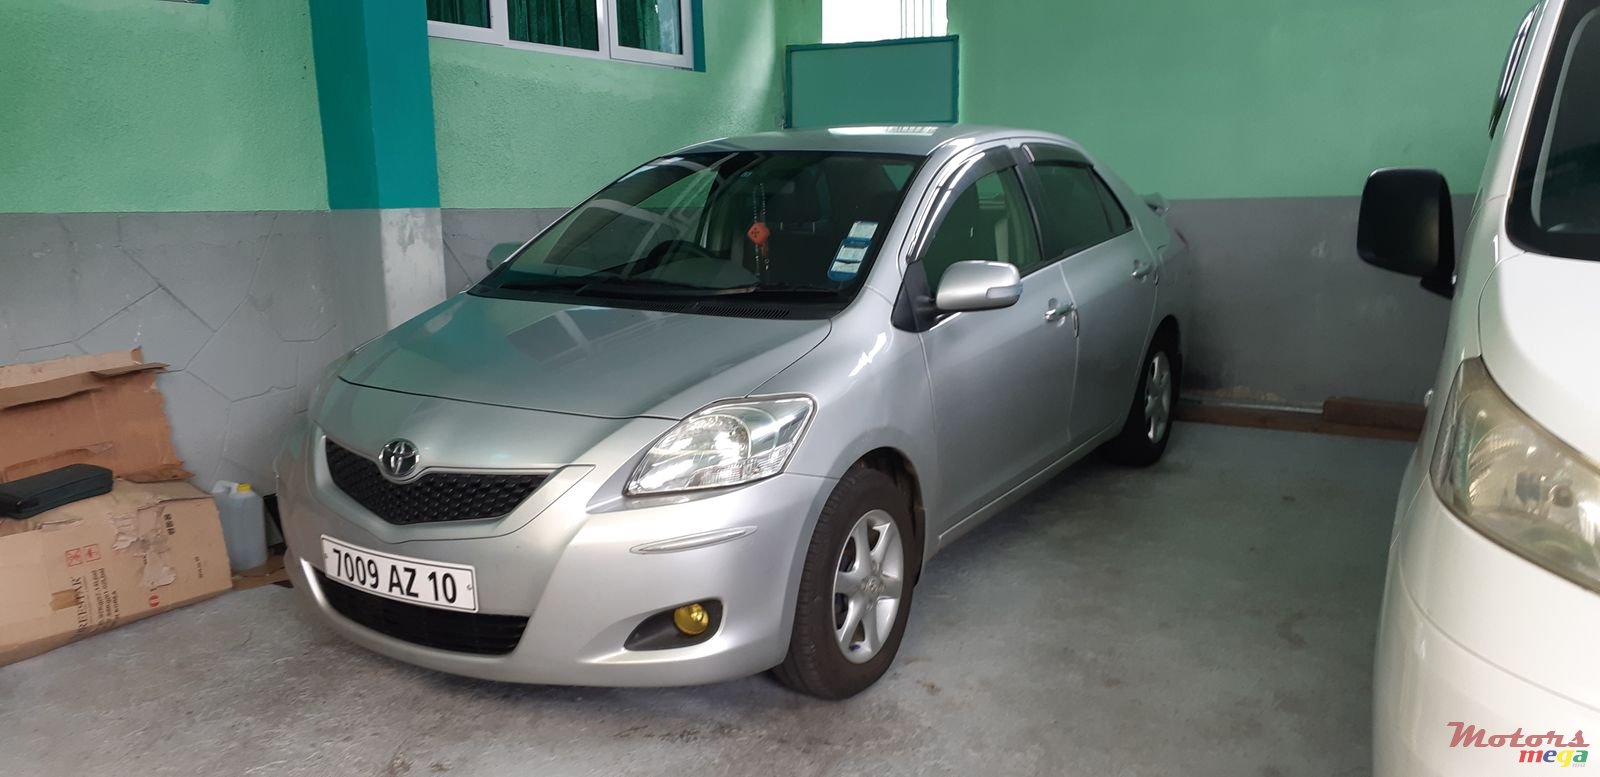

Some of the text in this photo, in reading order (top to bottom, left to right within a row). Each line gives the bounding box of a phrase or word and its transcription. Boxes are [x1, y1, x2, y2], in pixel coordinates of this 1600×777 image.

[332, 548, 457, 604] 7009 AZ 10
